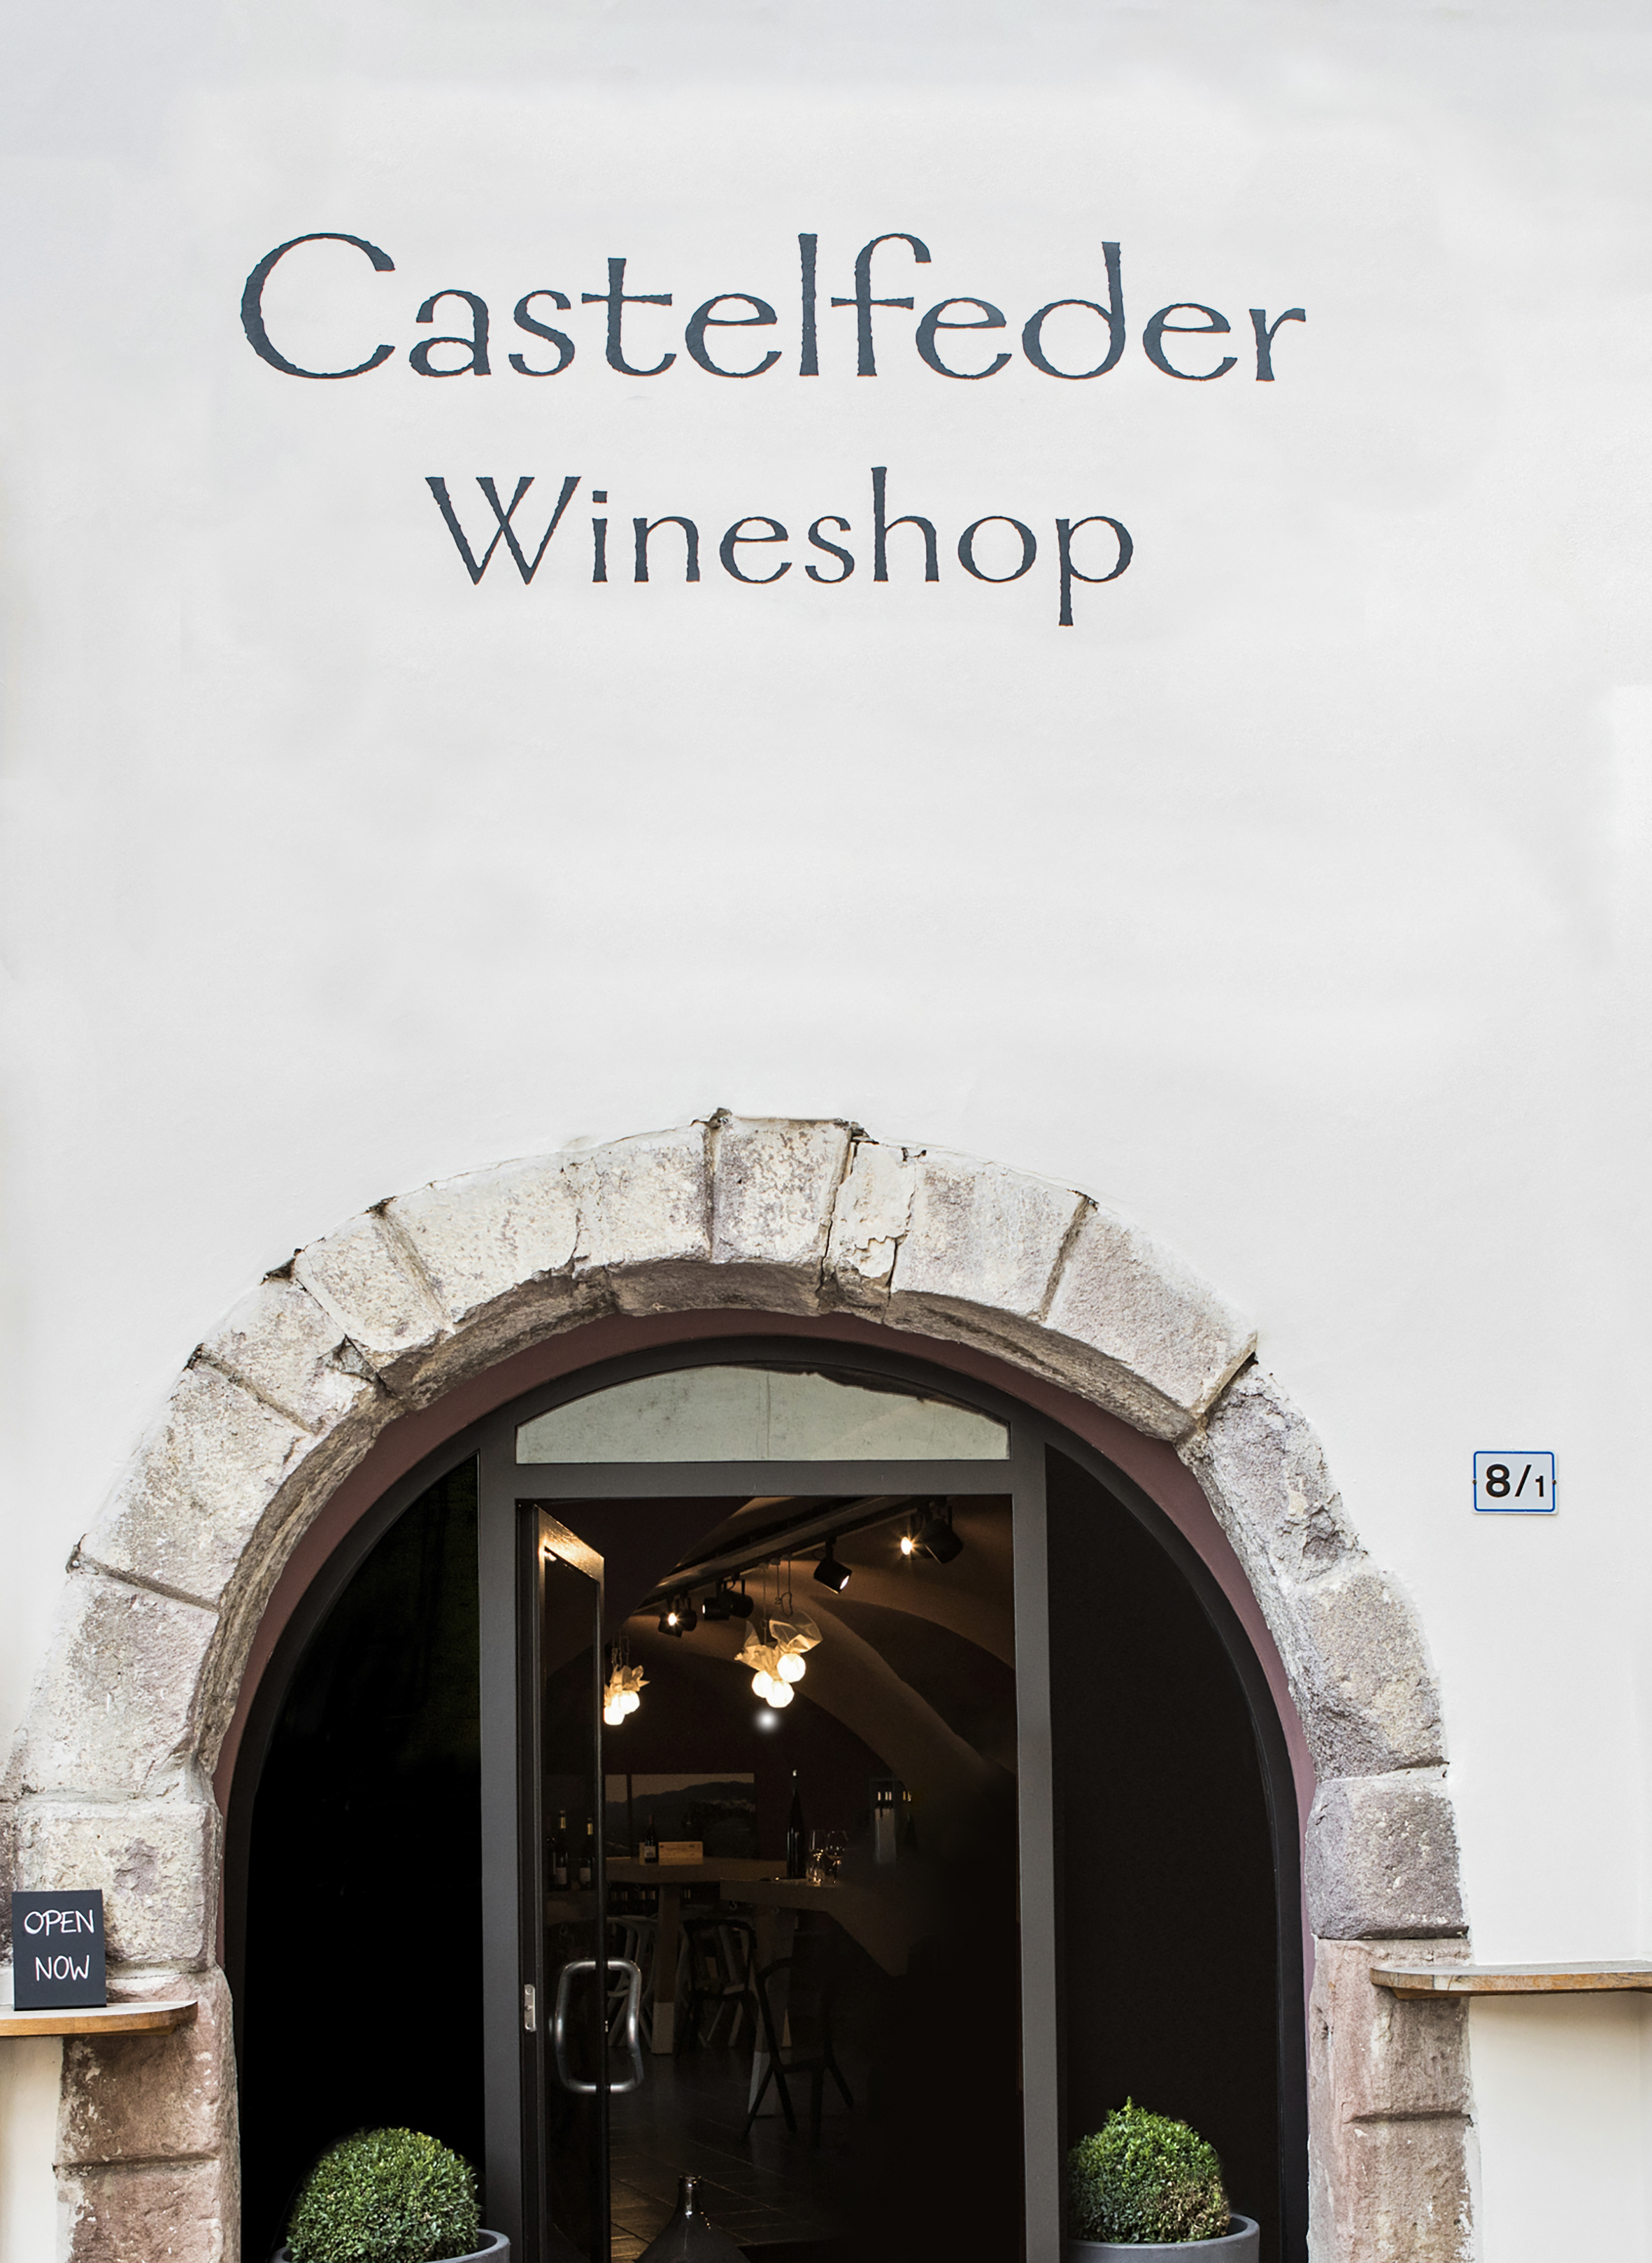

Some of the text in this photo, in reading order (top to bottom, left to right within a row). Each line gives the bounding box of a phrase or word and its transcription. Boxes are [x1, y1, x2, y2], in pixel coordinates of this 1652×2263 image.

[241, 233, 1306, 381] Castelfeder
[425, 467, 1133, 626] Wineshop
[1486, 1463, 1544, 1498] 8/1
[24, 1909, 94, 1936] OPEN
[35, 1955, 90, 1981] NOW
